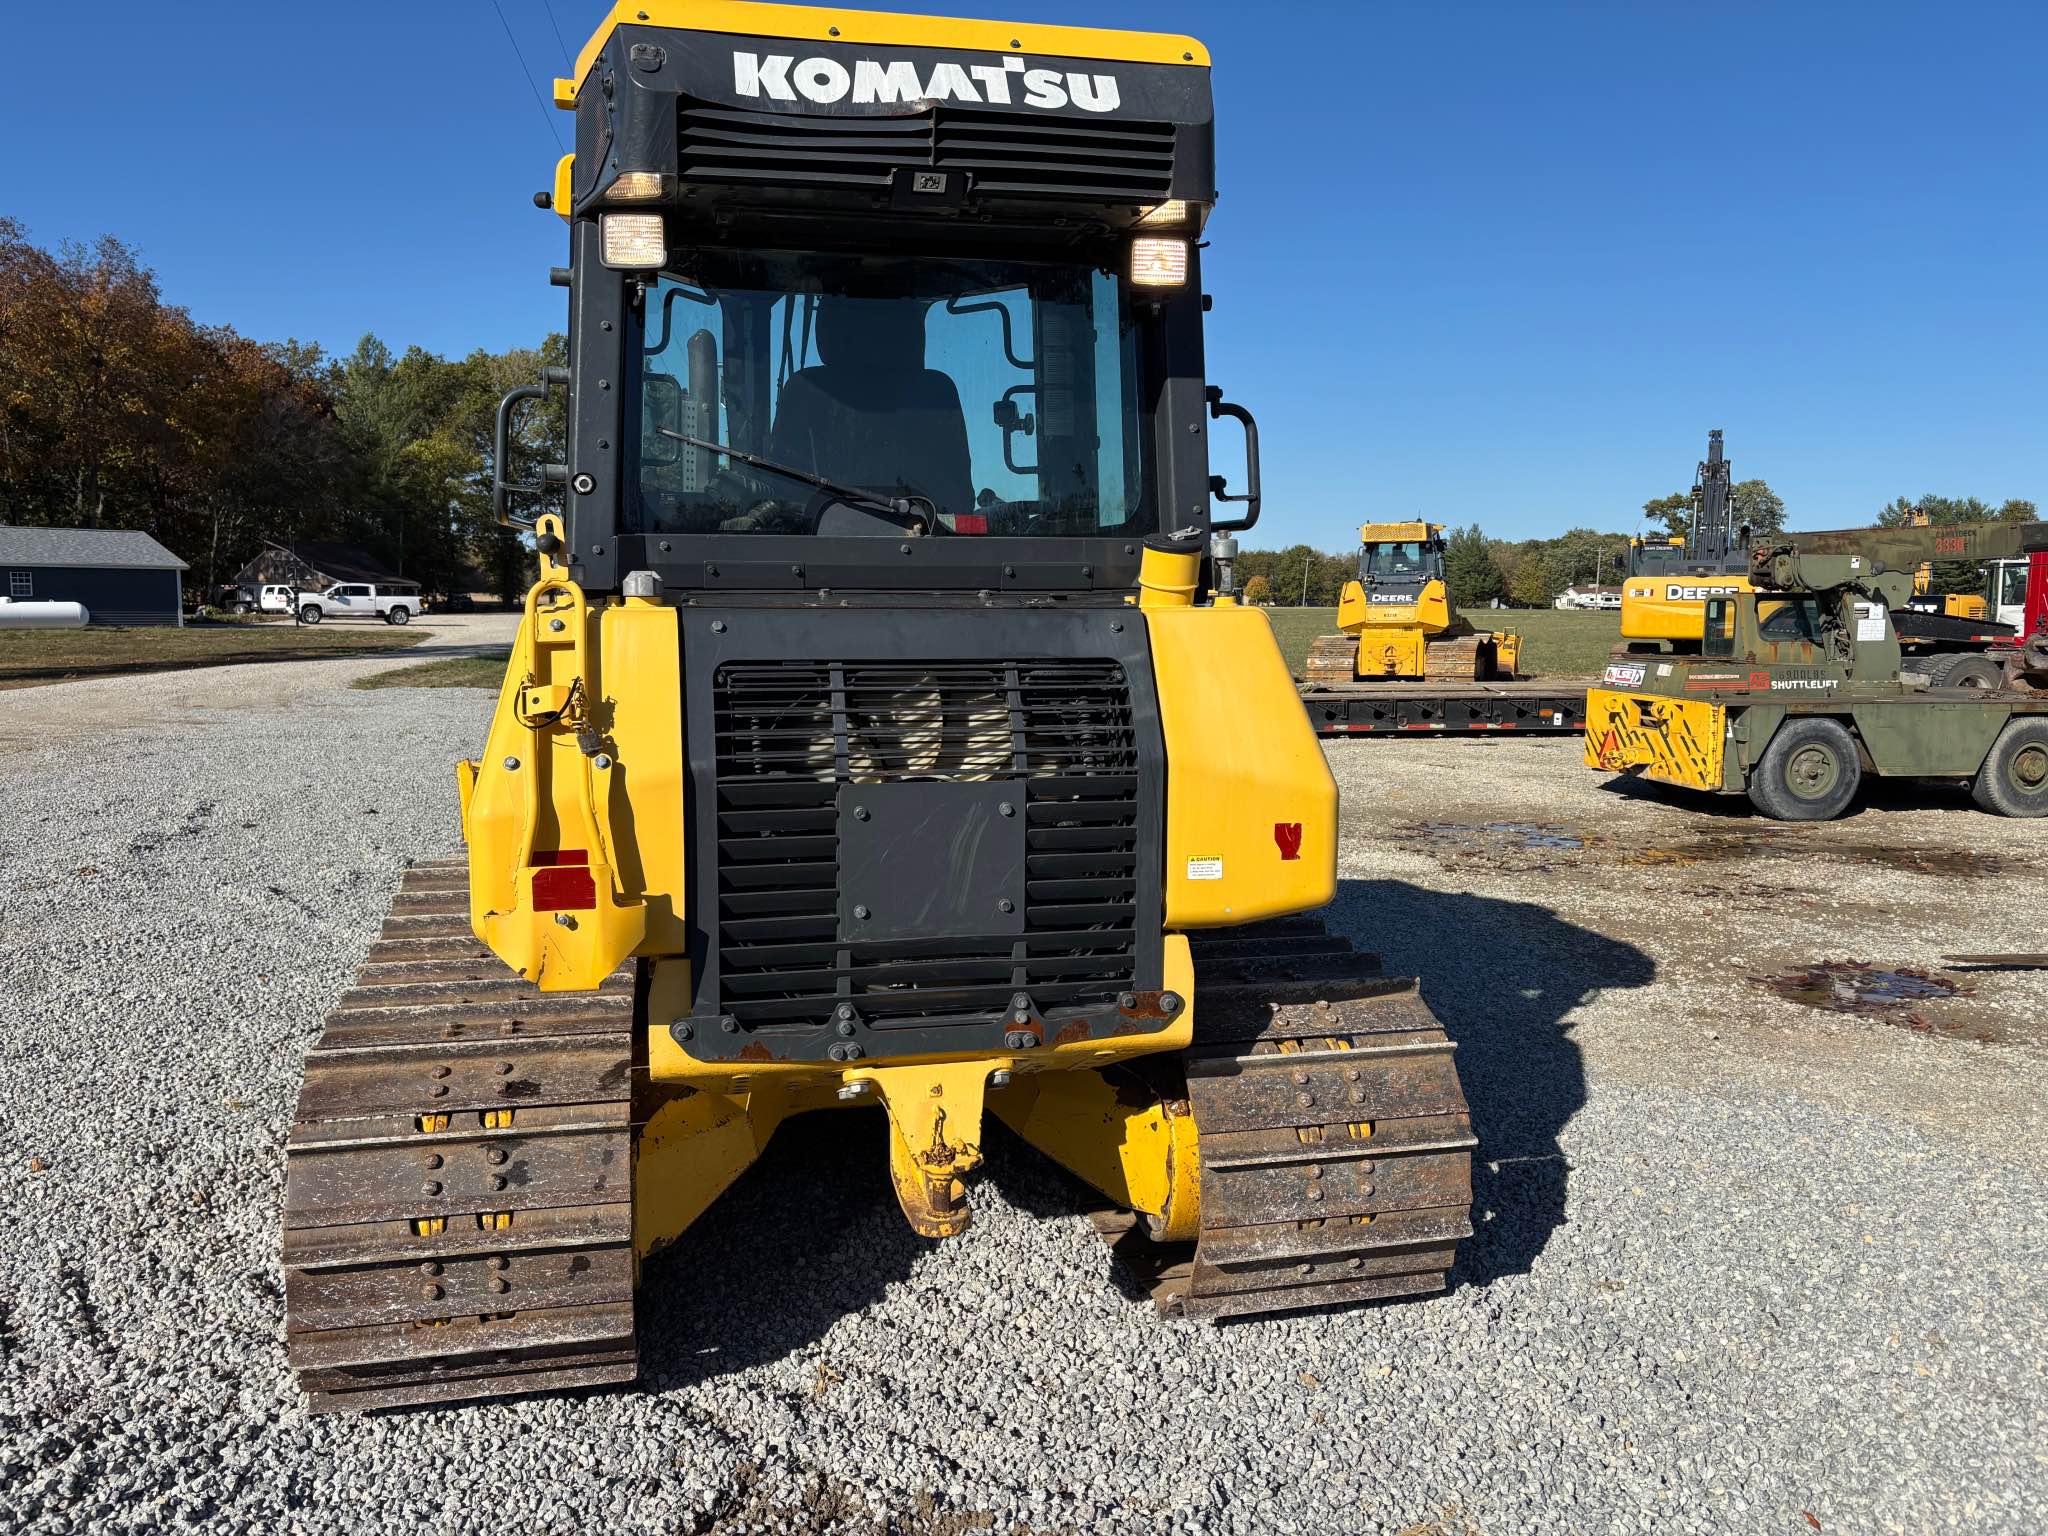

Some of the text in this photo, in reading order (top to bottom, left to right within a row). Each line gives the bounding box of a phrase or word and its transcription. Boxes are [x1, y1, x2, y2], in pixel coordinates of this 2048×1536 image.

[733, 51, 1121, 112] KOMATSU
[1373, 594, 1413, 602] DEERE
[1771, 680, 1839, 690] SHUTTLELIFT
